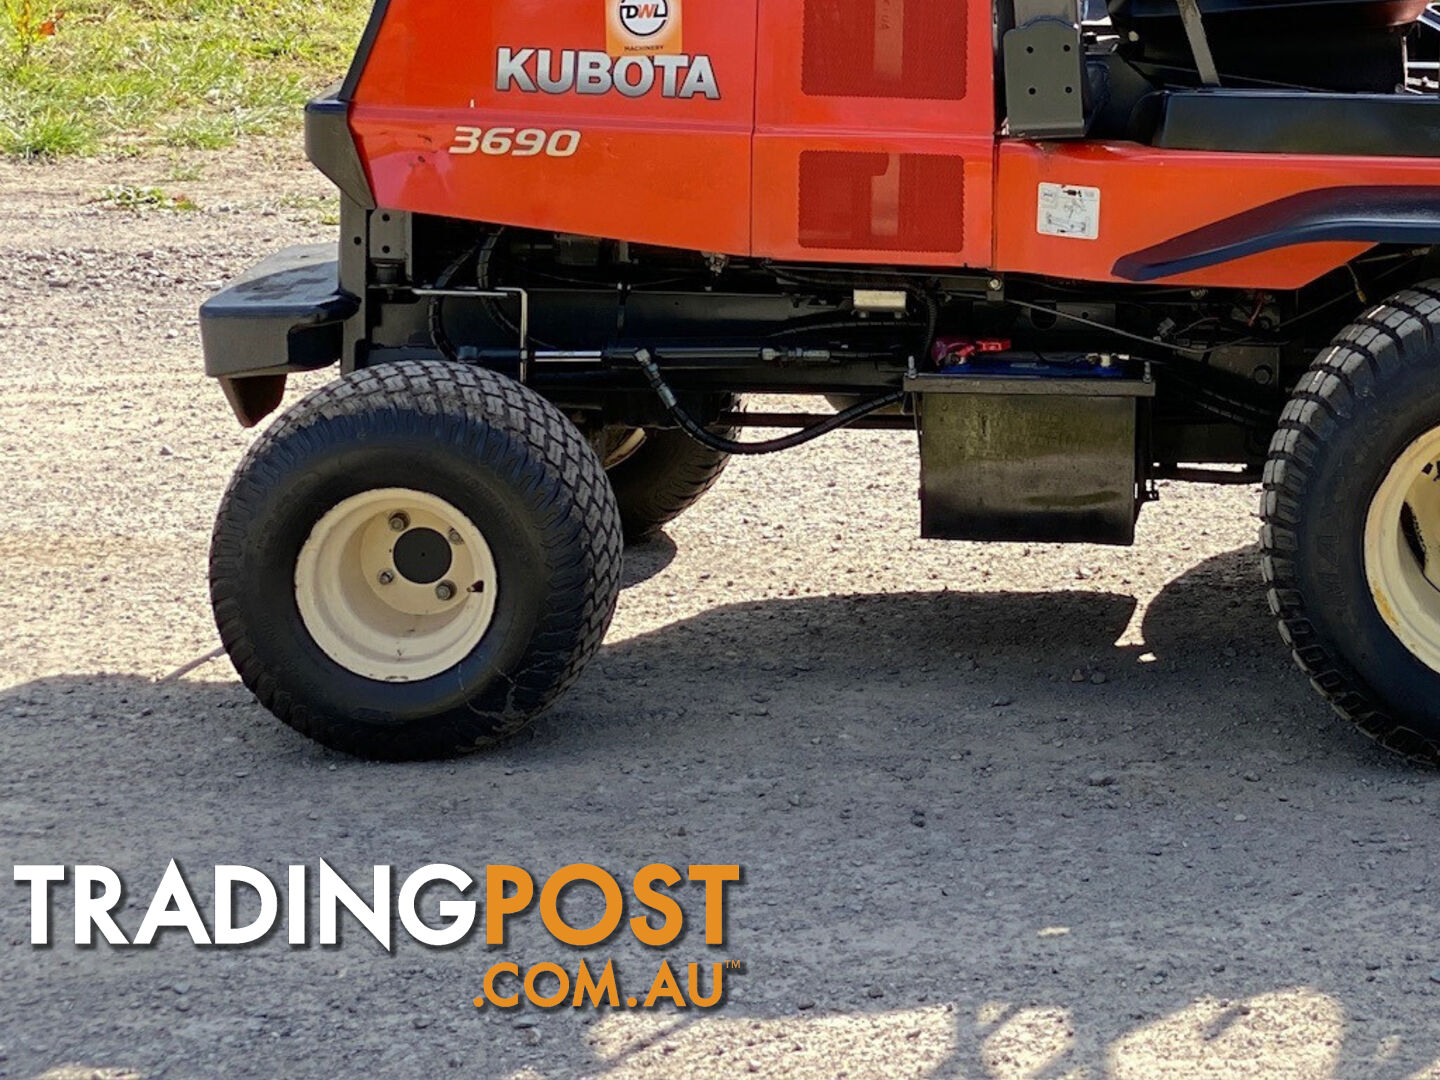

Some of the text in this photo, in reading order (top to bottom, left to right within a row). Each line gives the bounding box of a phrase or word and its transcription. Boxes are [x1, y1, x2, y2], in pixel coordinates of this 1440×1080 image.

[620, 4, 667, 19] DWL
[495, 46, 721, 99] KUBOTA
[449, 126, 581, 157] 3690
